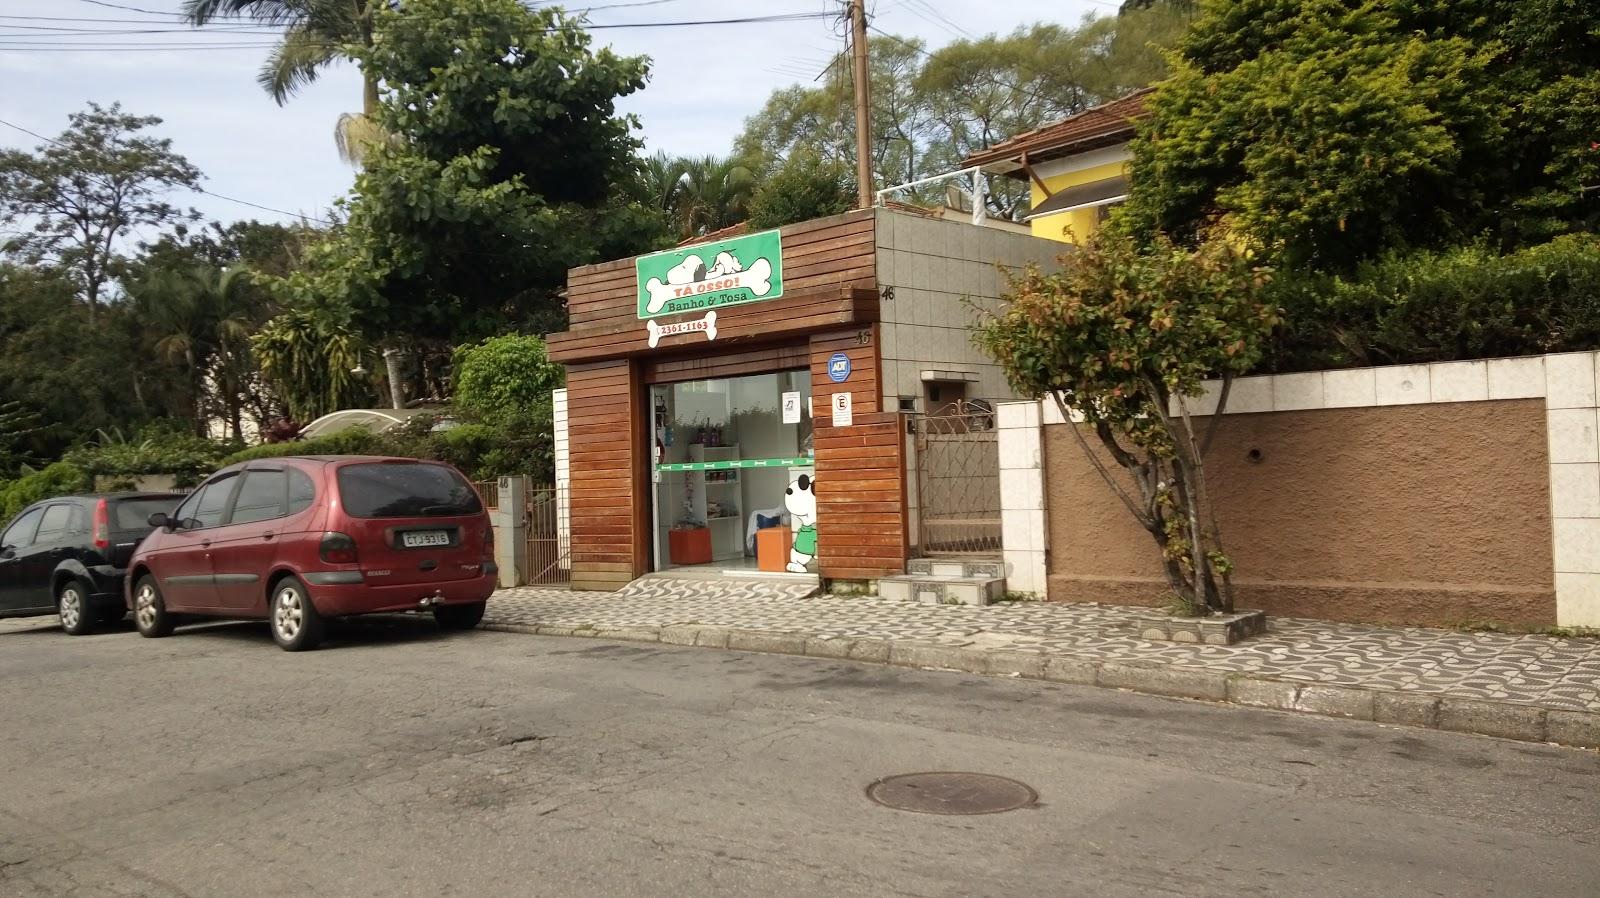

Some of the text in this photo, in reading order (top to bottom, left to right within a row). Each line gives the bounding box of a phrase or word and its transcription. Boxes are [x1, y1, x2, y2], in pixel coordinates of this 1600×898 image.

[697, 276, 740, 293] OSSO!
[881, 286, 895, 300] 46
[668, 292, 748, 312] Banho & Tosa
[661, 321, 708, 335] 2361-1163
[831, 361, 847, 373] ADT
[838, 398, 846, 408] E
